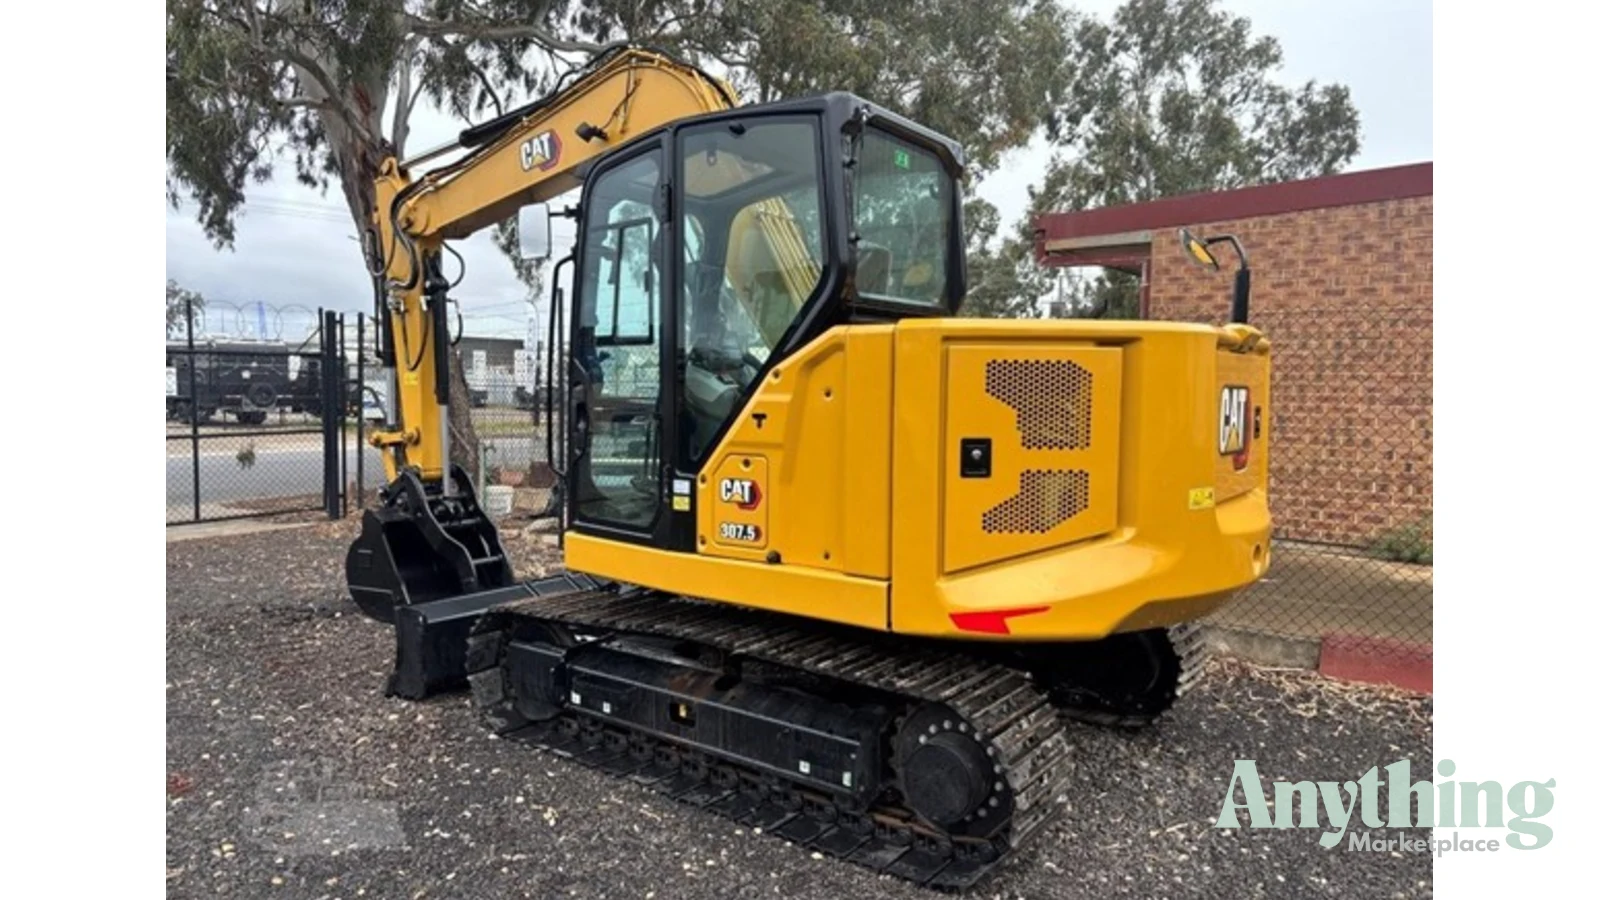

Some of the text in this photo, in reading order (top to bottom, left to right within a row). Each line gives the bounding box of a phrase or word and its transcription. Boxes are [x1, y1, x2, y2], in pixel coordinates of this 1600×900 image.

[520, 132, 551, 170] CAT
[1220, 387, 1248, 453] CAT
[721, 479, 752, 503] CAT
[720, 523, 755, 540] 307.5
